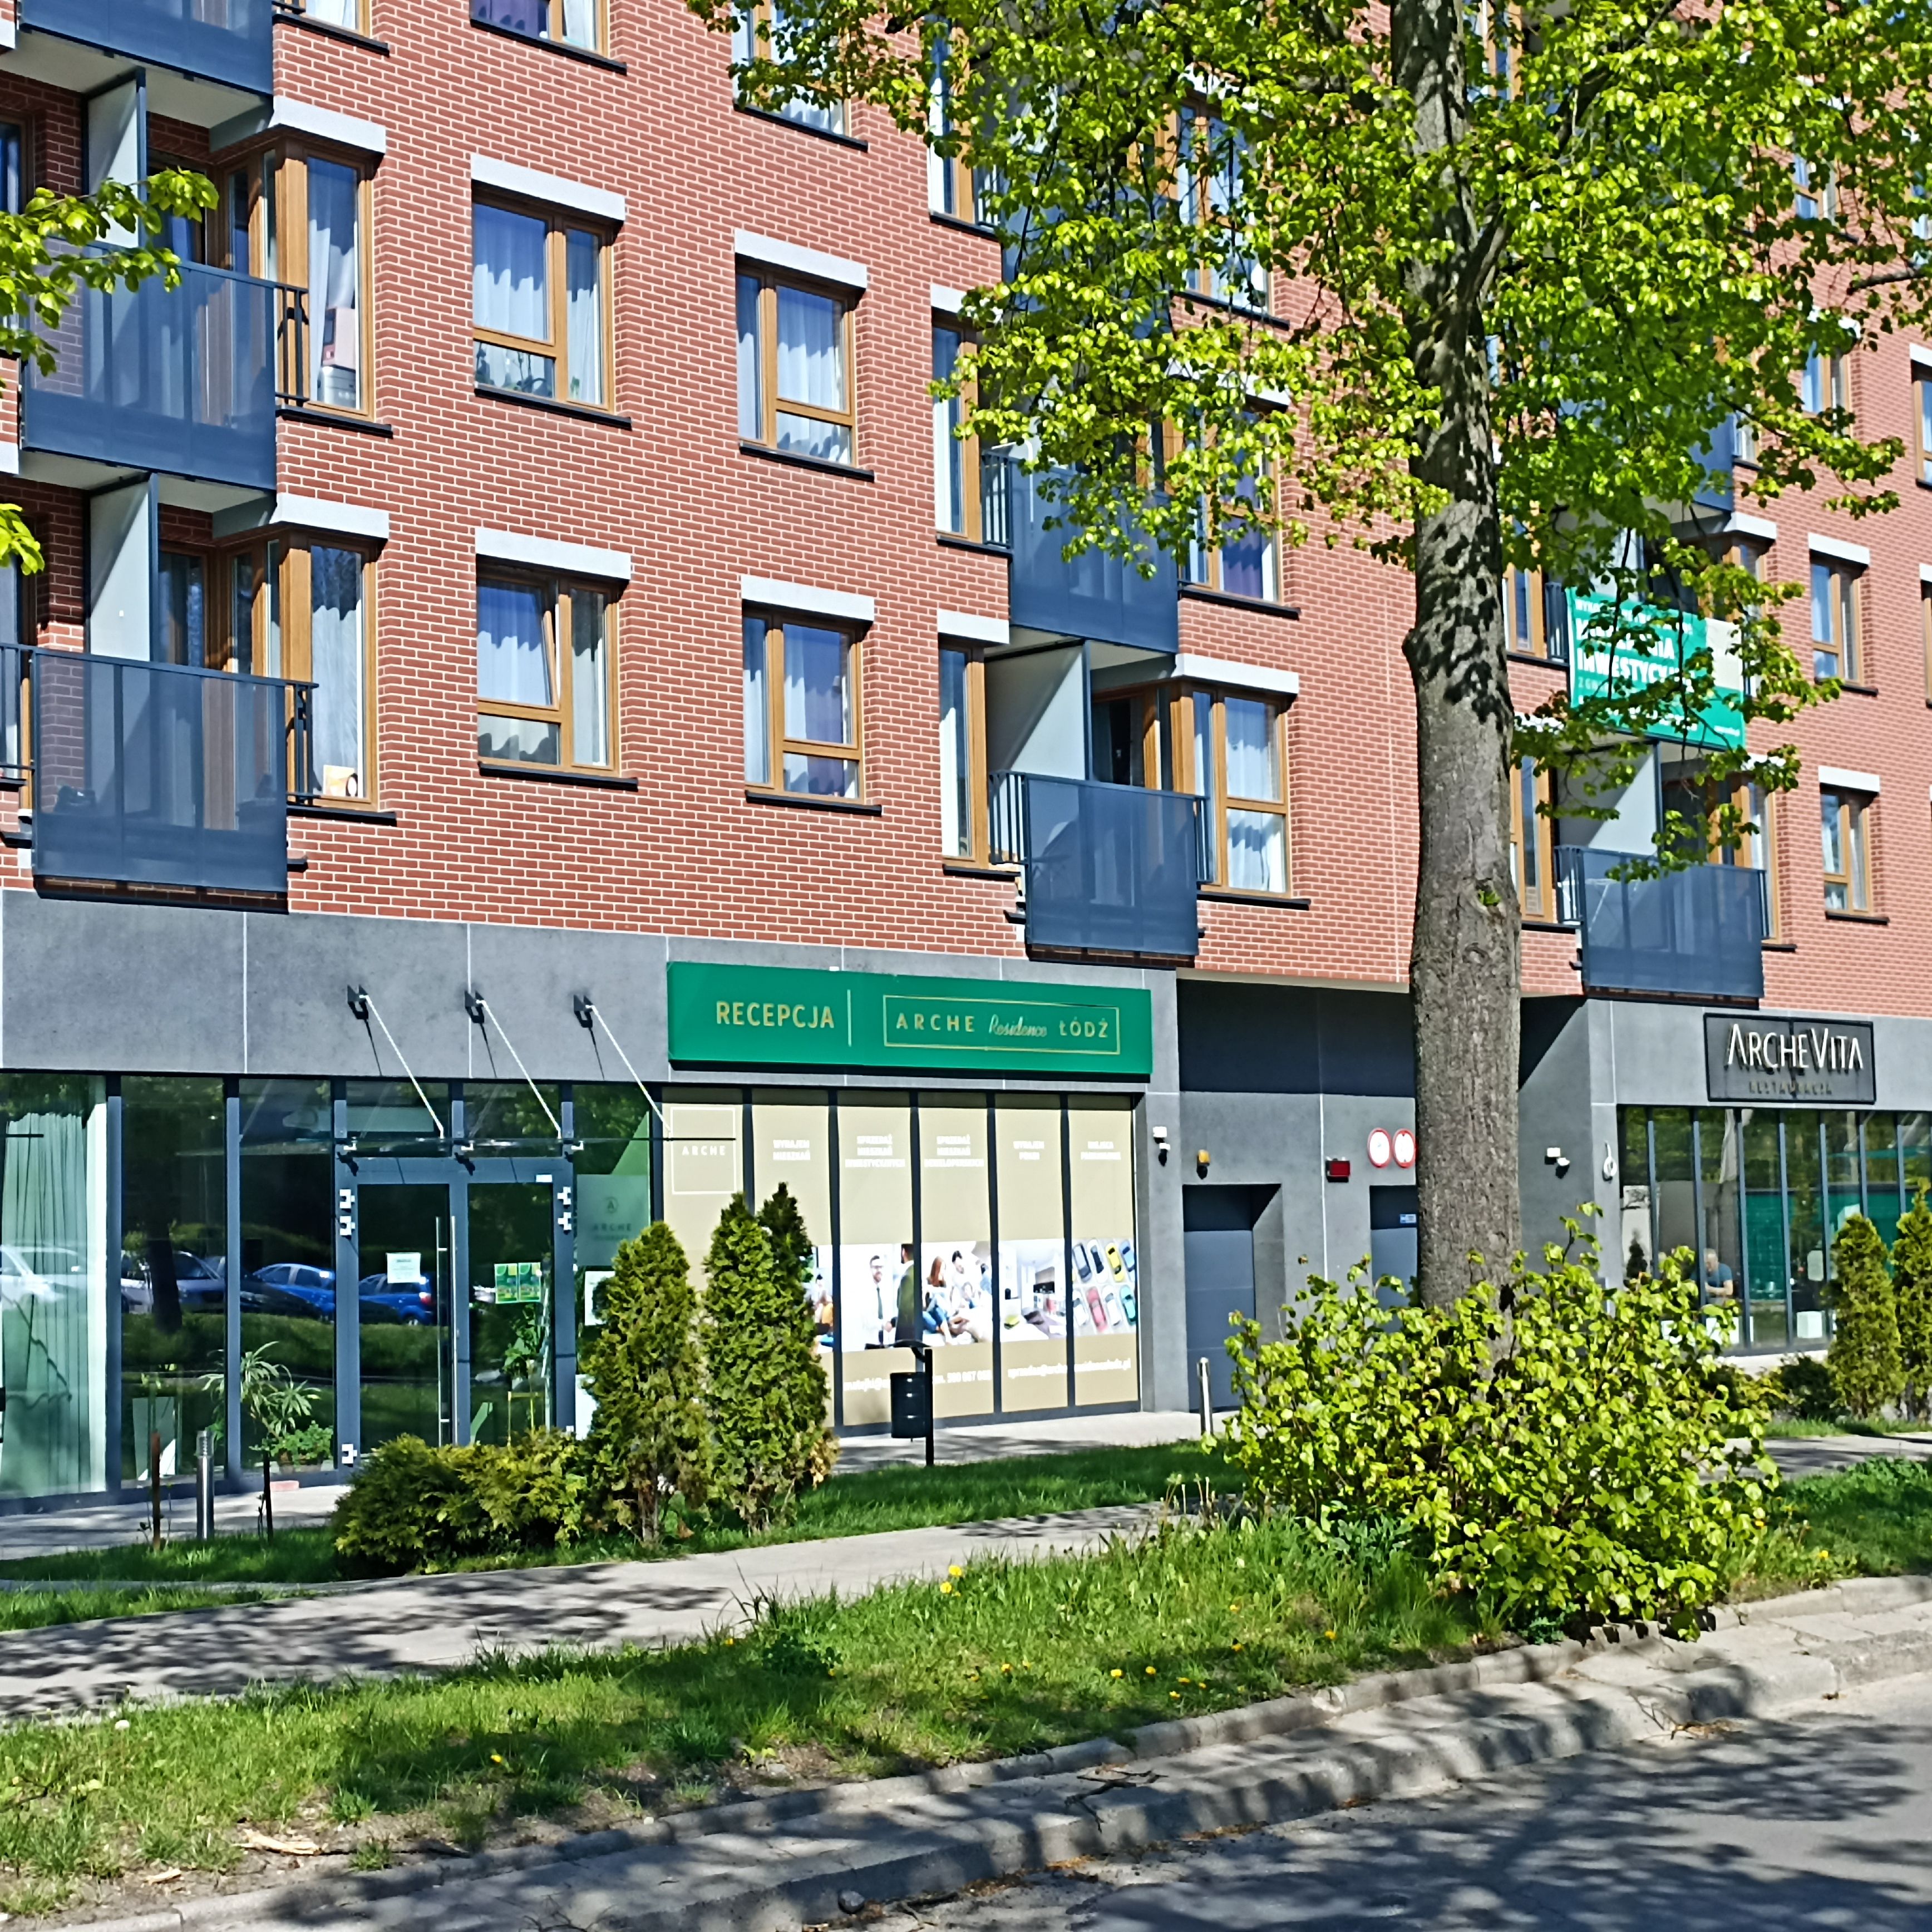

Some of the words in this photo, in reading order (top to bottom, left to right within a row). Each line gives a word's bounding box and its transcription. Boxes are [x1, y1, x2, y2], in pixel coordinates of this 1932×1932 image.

[716, 1001, 835, 1029] RECEPCJA
[895, 1013, 975, 1032] ARCHE
[989, 1014, 1048, 1038] Residence
[1059, 1017, 1109, 1038] ŁÓDŹ
[682, 1145, 726, 1156] ARCHE
